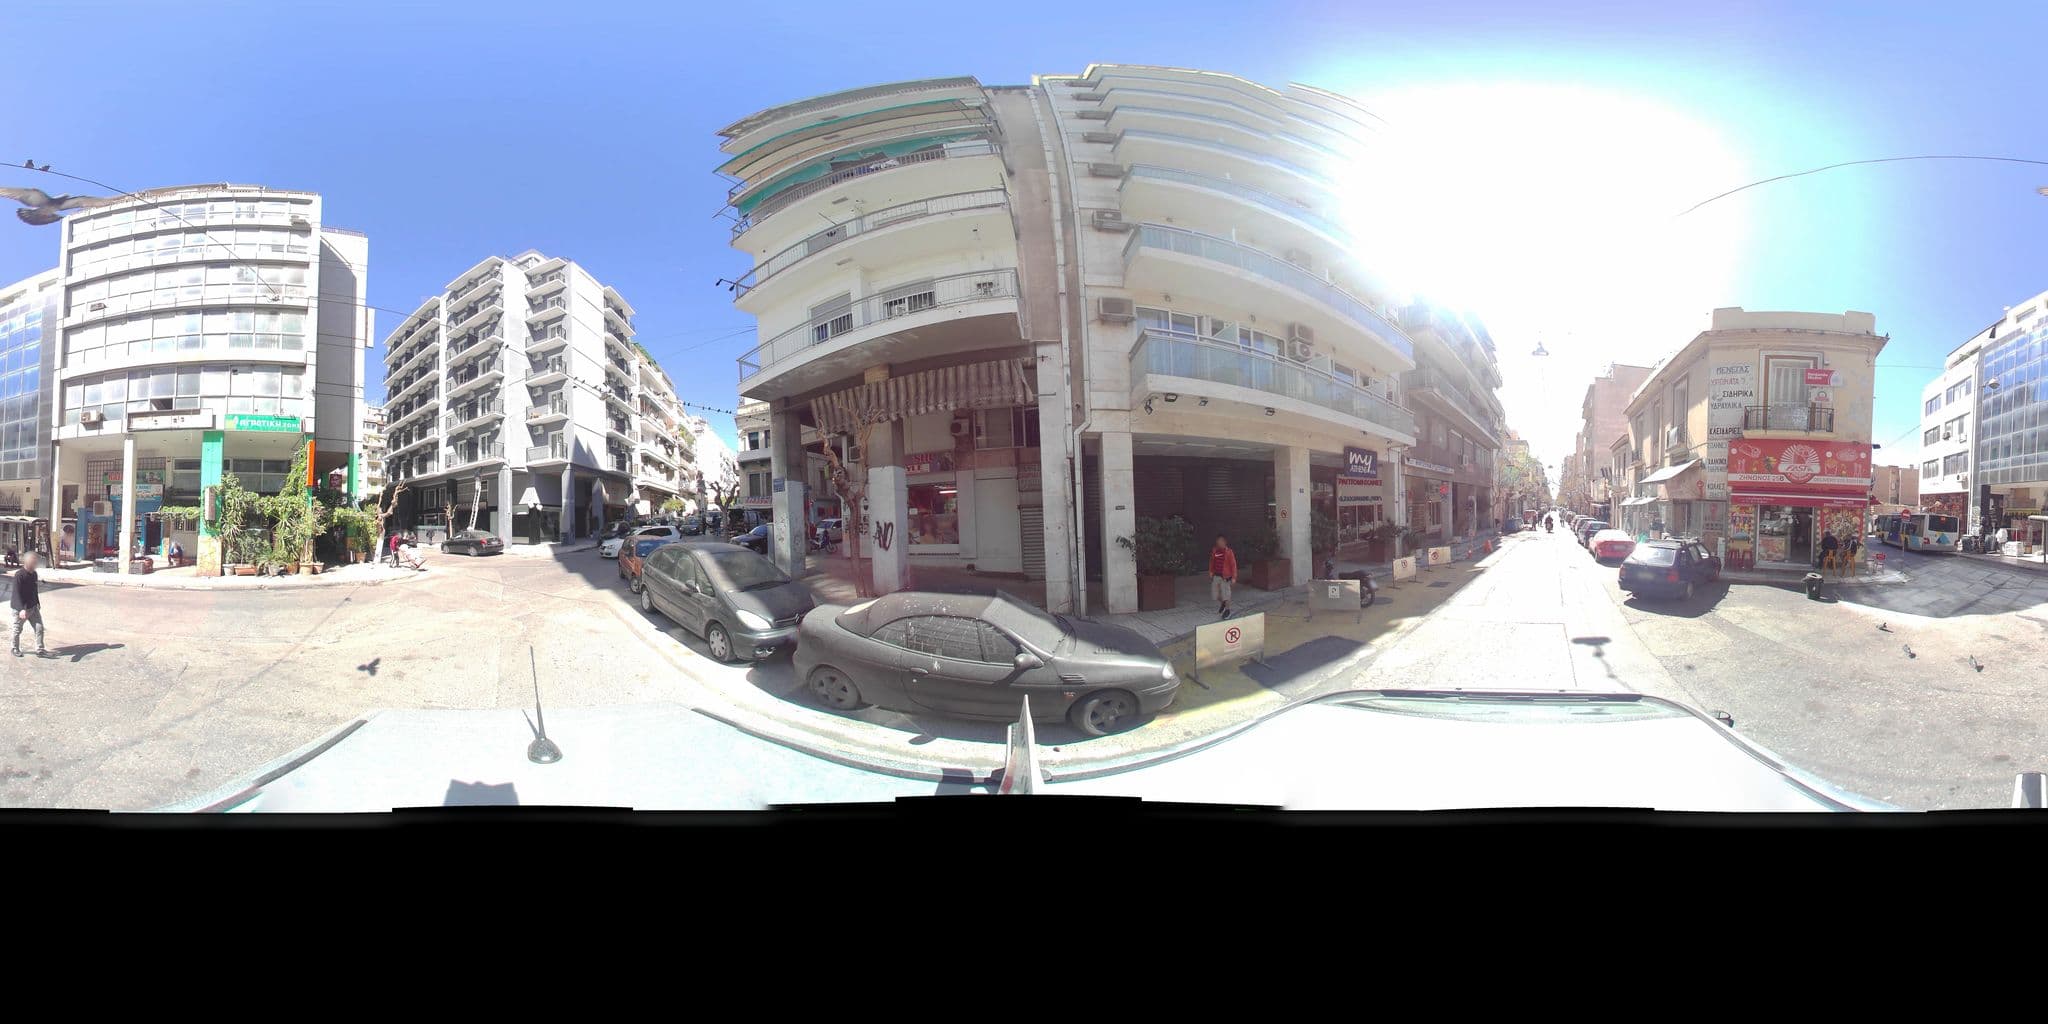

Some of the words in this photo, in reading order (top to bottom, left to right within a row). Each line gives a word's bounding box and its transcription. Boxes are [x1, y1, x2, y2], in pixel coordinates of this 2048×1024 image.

[1722, 390, 1753, 398] ΣΙΔΗΡΙΚΑ
[1709, 427, 1741, 435] ΚΛΕΙΔΑΡΙΕΣ
[1350, 452, 1372, 472] my
